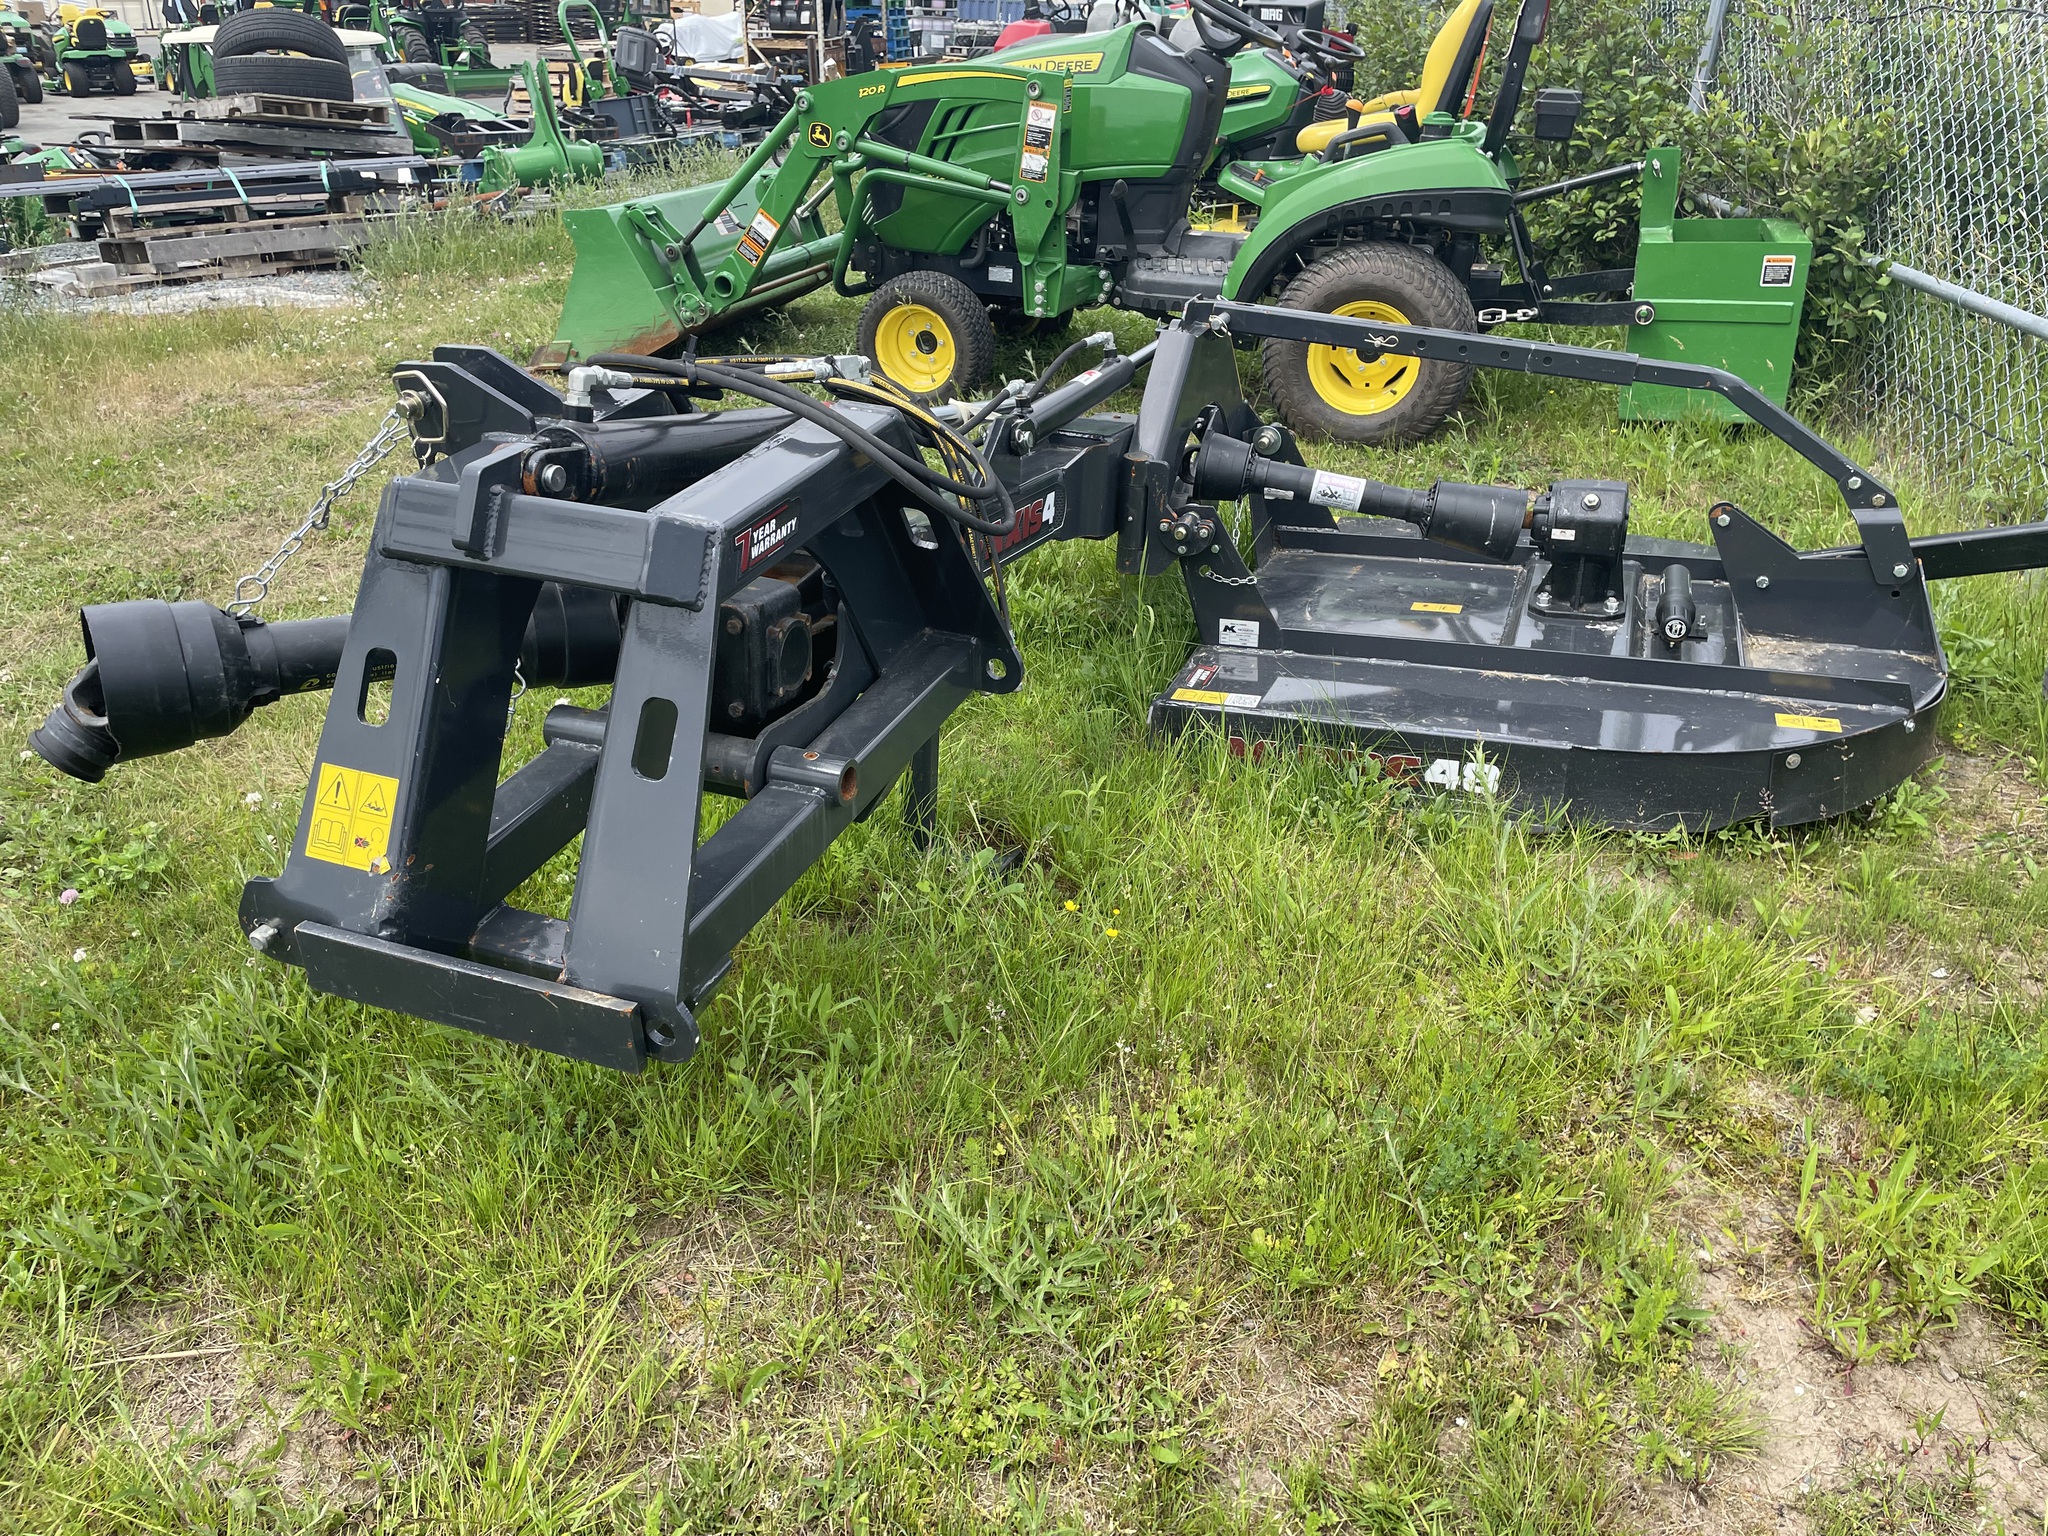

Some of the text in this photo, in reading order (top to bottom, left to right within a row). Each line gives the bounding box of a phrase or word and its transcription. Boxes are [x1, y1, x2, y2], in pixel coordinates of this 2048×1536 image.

[1260, 8, 1283, 21] MAG
[1046, 60, 1093, 71] DEERE
[751, 516, 798, 560] WARRANTY
[752, 518, 776, 544] YEAR
[734, 527, 752, 573] 7
